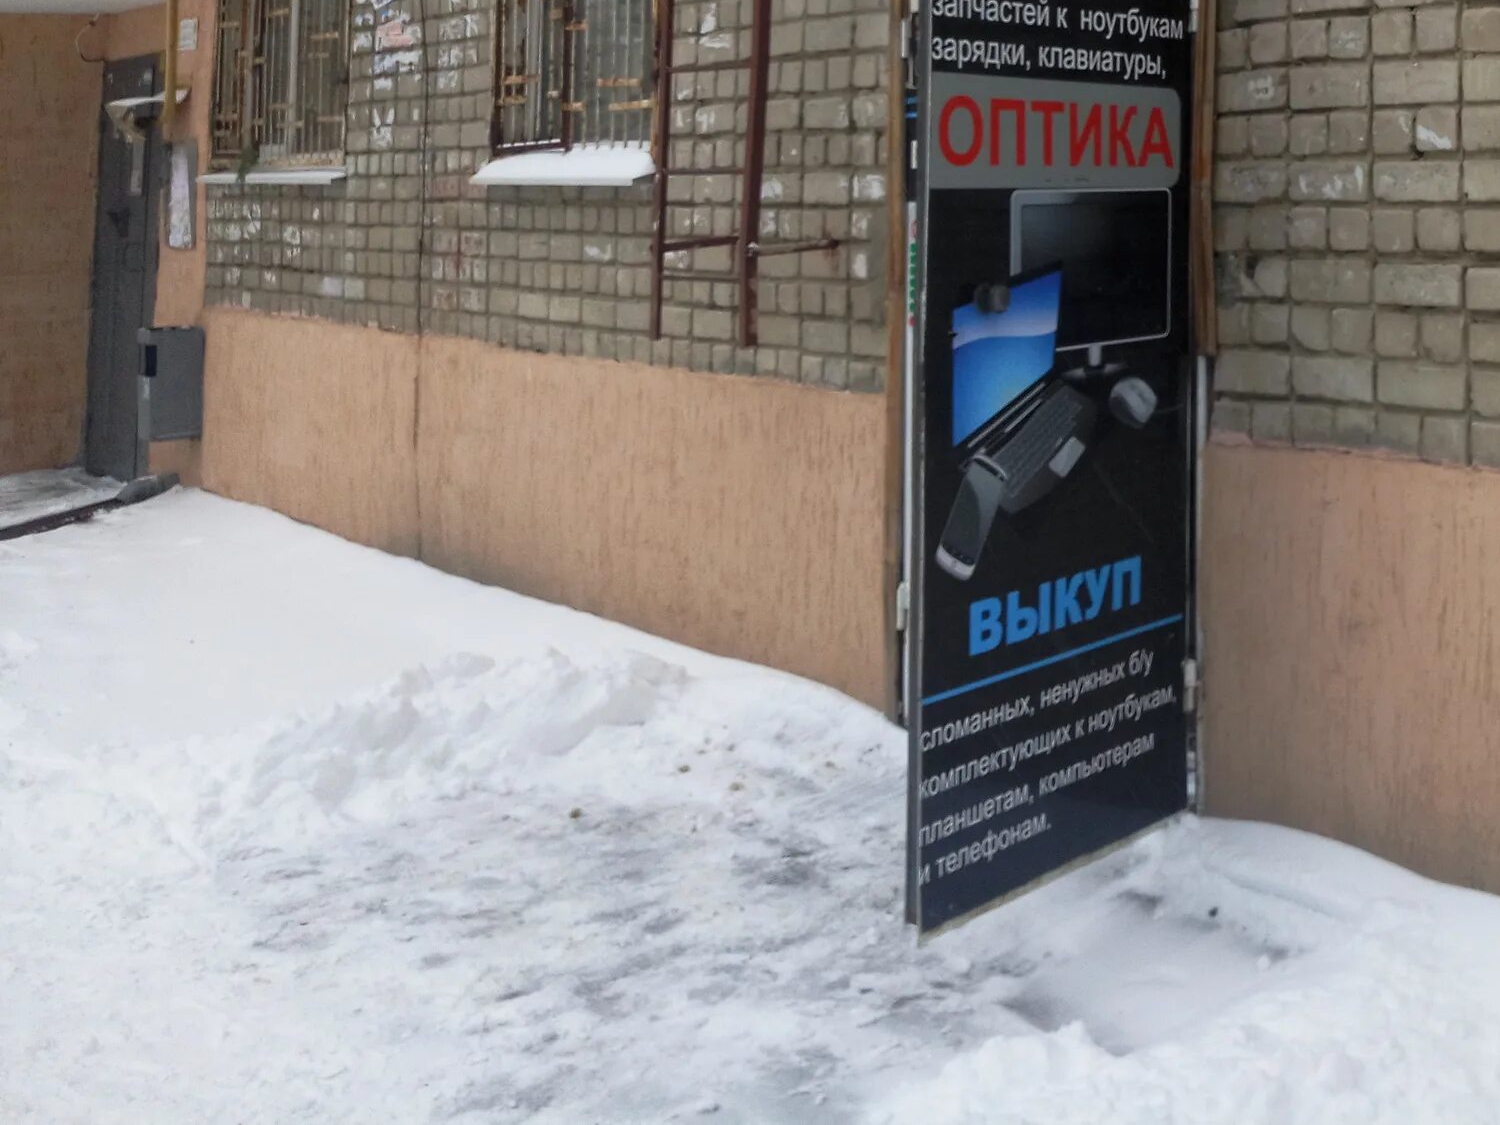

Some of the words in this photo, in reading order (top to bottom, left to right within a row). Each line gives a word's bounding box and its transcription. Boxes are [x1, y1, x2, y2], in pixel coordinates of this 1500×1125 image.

[932, 37, 1032, 71] зарядки,
[1038, 44, 1167, 80] клавиатуры,
[1056, 9, 1068, 30] к
[1080, 8, 1184, 41] ноутбукам
[937, 94, 1174, 169] ОПТИКА
[968, 555, 1143, 657] ВЫКУП
[920, 695, 1035, 752] сломанных,
[1040, 660, 1125, 712] ненужных
[1129, 647, 1154, 677] б/у
[918, 785, 1035, 847] планшетам,
[1039, 732, 1155, 793] компьютерам
[920, 725, 1072, 799] комплектующих
[1075, 720, 1085, 740] к
[919, 861, 930, 885] и
[936, 813, 1052, 879] телефонам.
